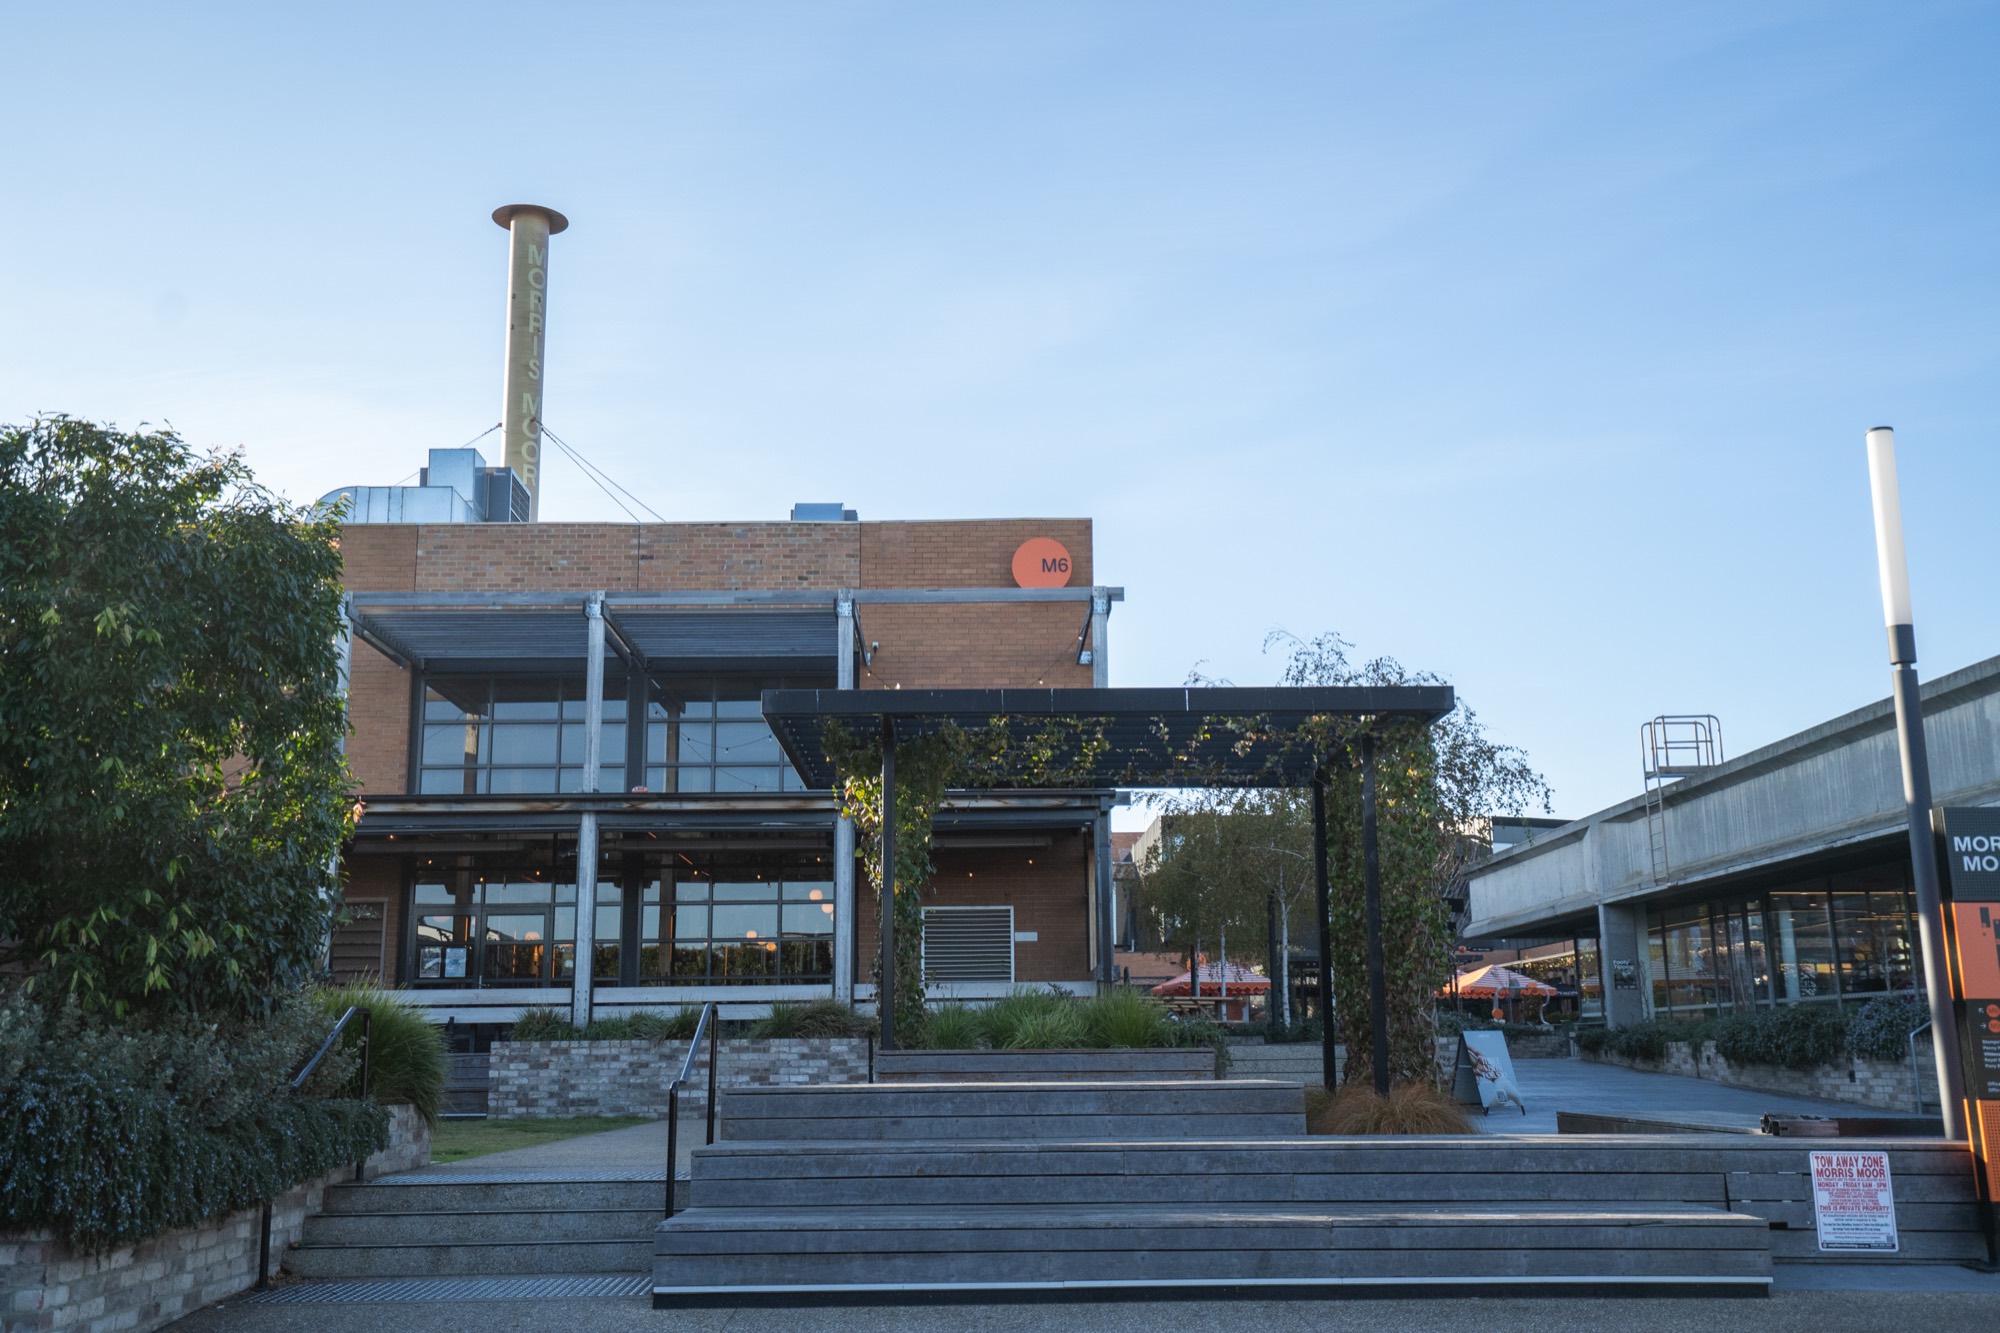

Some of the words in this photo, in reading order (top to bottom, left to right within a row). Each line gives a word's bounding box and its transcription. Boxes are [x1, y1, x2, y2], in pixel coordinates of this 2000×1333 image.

[528, 244, 545, 380] MORRIS
[521, 393, 540, 487] MOOR
[1042, 557, 1068, 573] M6
[1963, 855, 1999, 871] MO
[1815, 1156, 1833, 1167] TOW
[1836, 1156, 1859, 1167] AWAY
[1862, 1156, 1884, 1167] ZONE
[1816, 1168, 1853, 1177] MORRIS
[1857, 1168, 1885, 1177] MOOR
